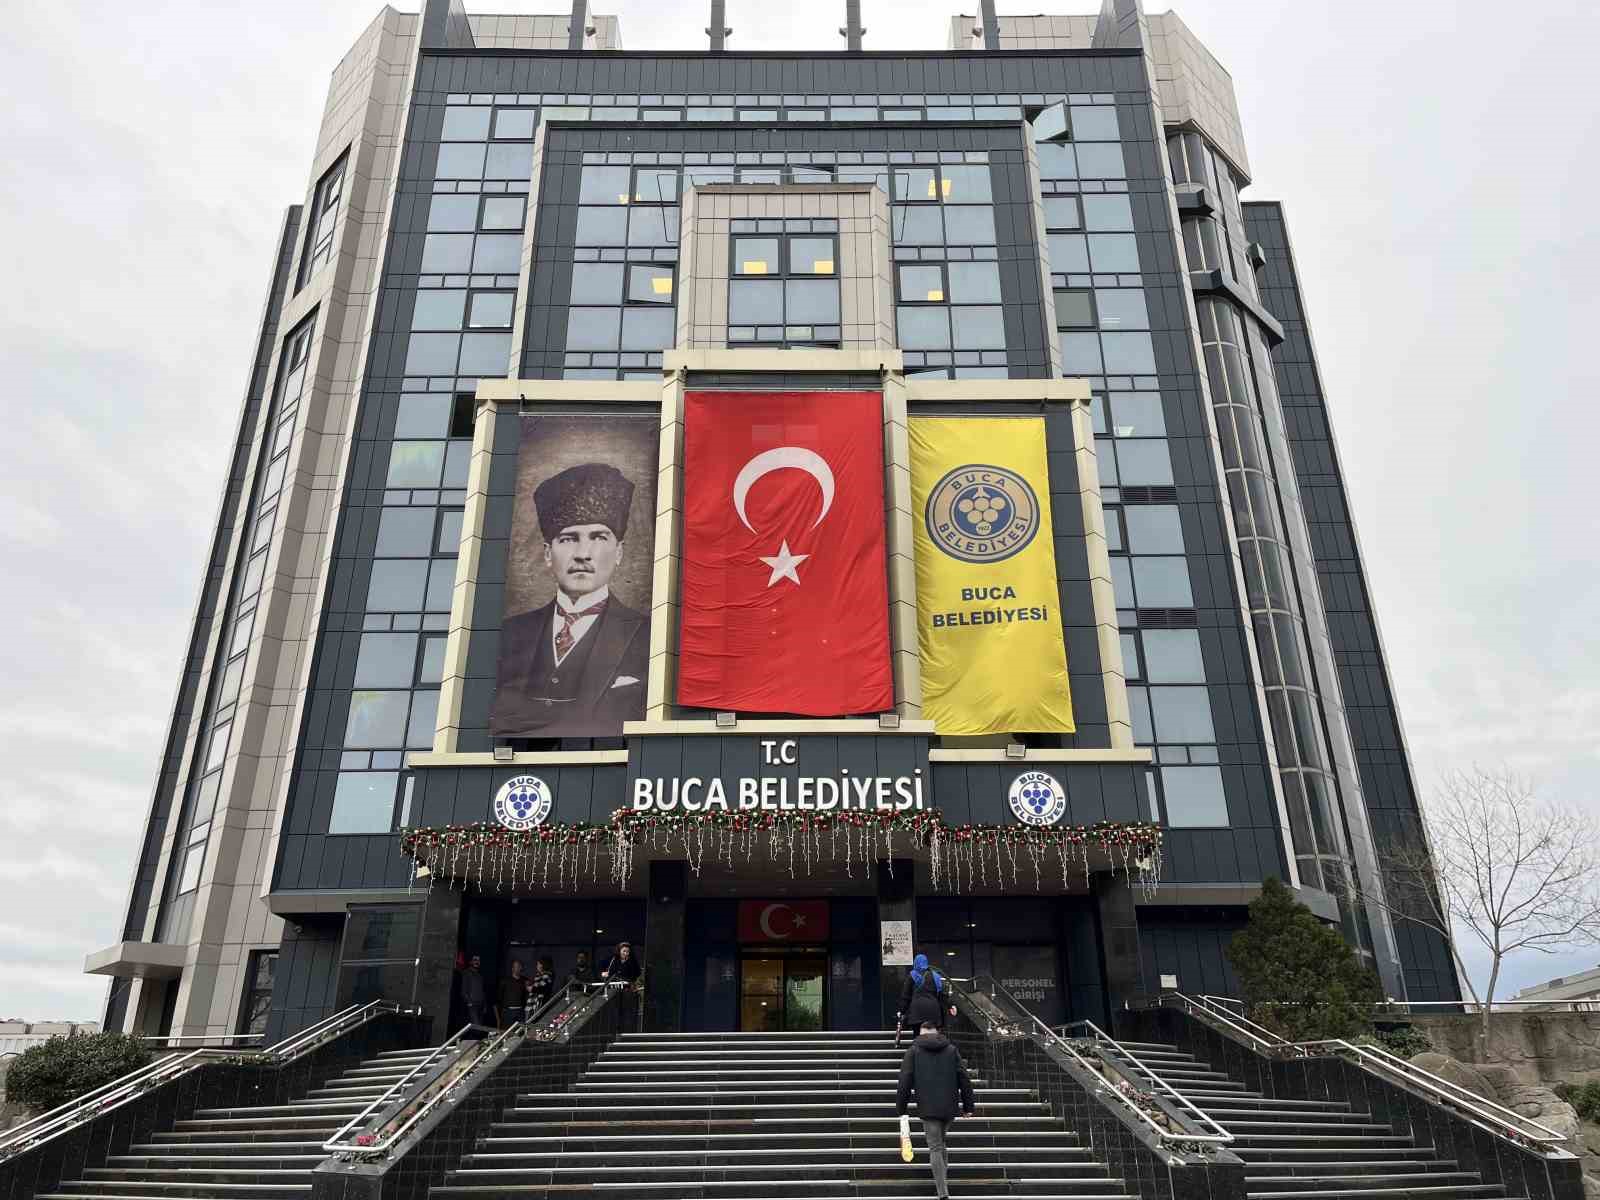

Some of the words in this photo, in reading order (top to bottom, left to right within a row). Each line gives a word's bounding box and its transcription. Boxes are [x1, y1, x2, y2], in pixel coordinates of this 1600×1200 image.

[952, 474, 1005, 490] BUCA
[961, 586, 1016, 600] BUCA
[933, 605, 1047, 627] BELEDİYESİ
[761, 740, 797, 765] T.C
[508, 778, 541, 789] BUCA
[1019, 774, 1052, 785] BUCA
[633, 778, 729, 811] BUCA
[738, 769, 924, 810] BELEDİYESİ
[1000, 978, 1056, 987] PERSONEL
